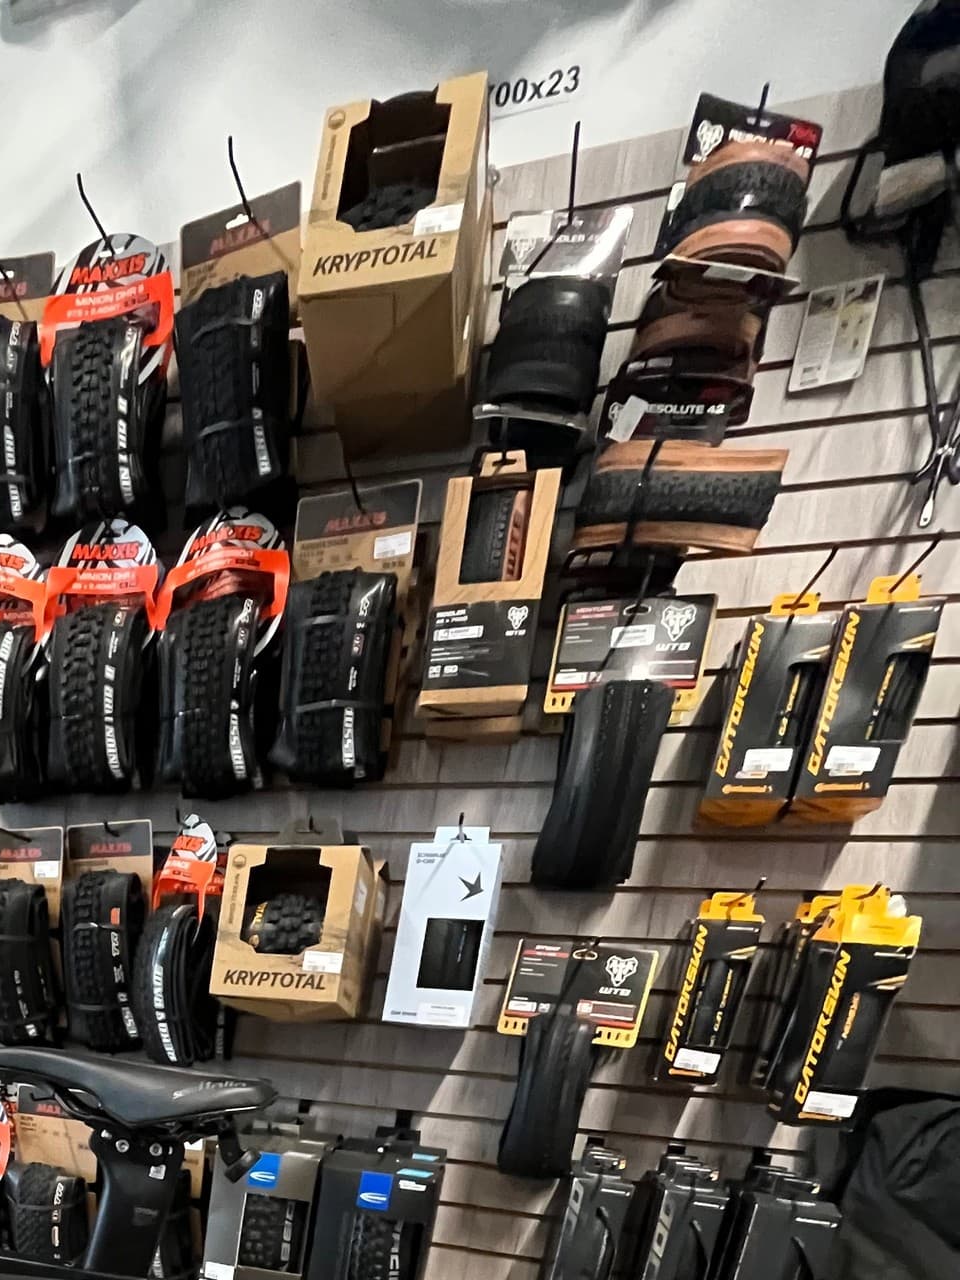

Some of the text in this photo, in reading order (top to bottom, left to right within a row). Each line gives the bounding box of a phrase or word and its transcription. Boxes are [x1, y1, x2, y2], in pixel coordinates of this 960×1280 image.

[488, 65, 581, 107] 00x23
[71, 255, 147, 284] MAXXIS
[312, 238, 438, 277] KRYPTOTAL
[707, 403, 725, 414] 42
[72, 542, 141, 560] MAXXIS
[655, 641, 691, 652] WTB
[715, 622, 765, 778] GATORSKIN
[807, 611, 861, 777] GATORSKIN
[223, 968, 327, 991] KRYPTOTAL
[598, 986, 632, 997] WTB
[665, 924, 709, 1063] GATORSKIN
[795, 950, 852, 1105] GATORSKIN
[36, 1103, 62, 1115] MAX
